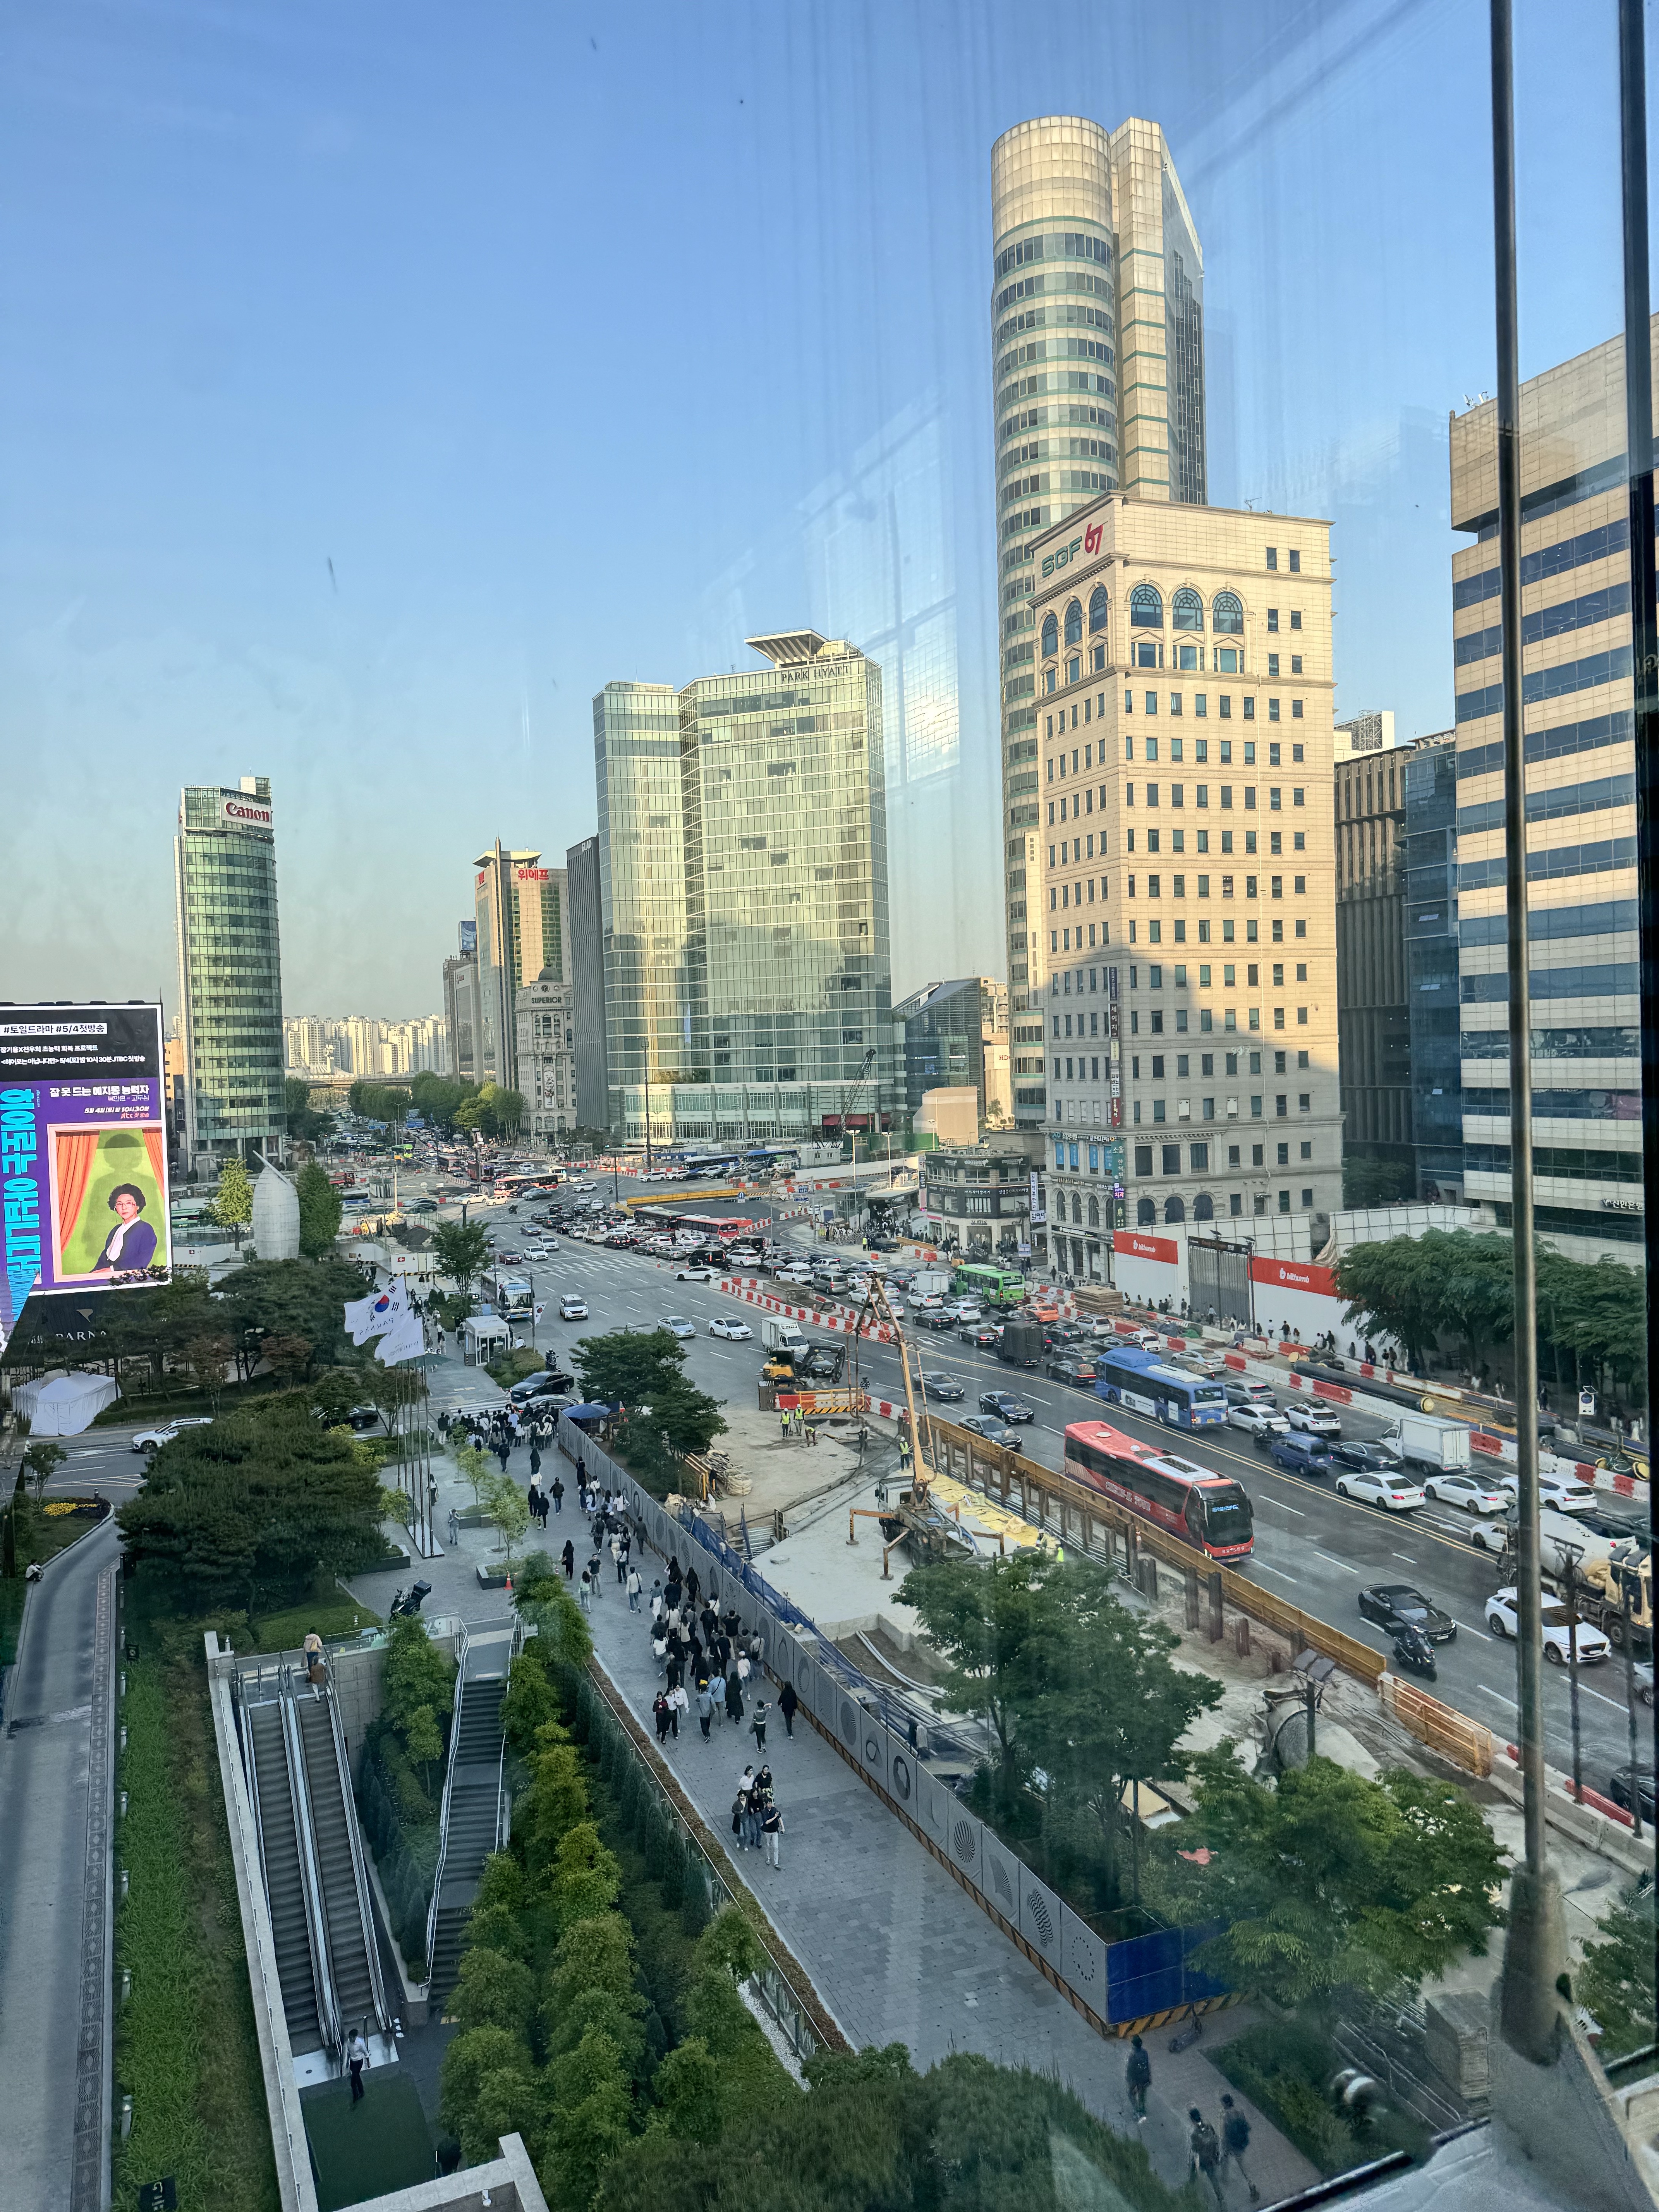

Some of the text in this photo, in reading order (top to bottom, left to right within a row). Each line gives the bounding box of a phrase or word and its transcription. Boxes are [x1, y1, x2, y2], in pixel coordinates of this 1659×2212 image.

[1042, 523, 1103, 578] SGF 67
[782, 665, 850, 682] PARK HYATT
[226, 802, 270, 822] Canon
[581, 840, 592, 852] GLAD
[518, 869, 549, 880] 위메프
[4, 1024, 105, 1034] #토일드라마 #5/4첫방송
[50, 1085, 149, 1097] 잠 못 드는 예지몽 능력자
[0, 1089, 37, 1175] 히어로는
[1287, 1272, 1310, 1283] bithumb
